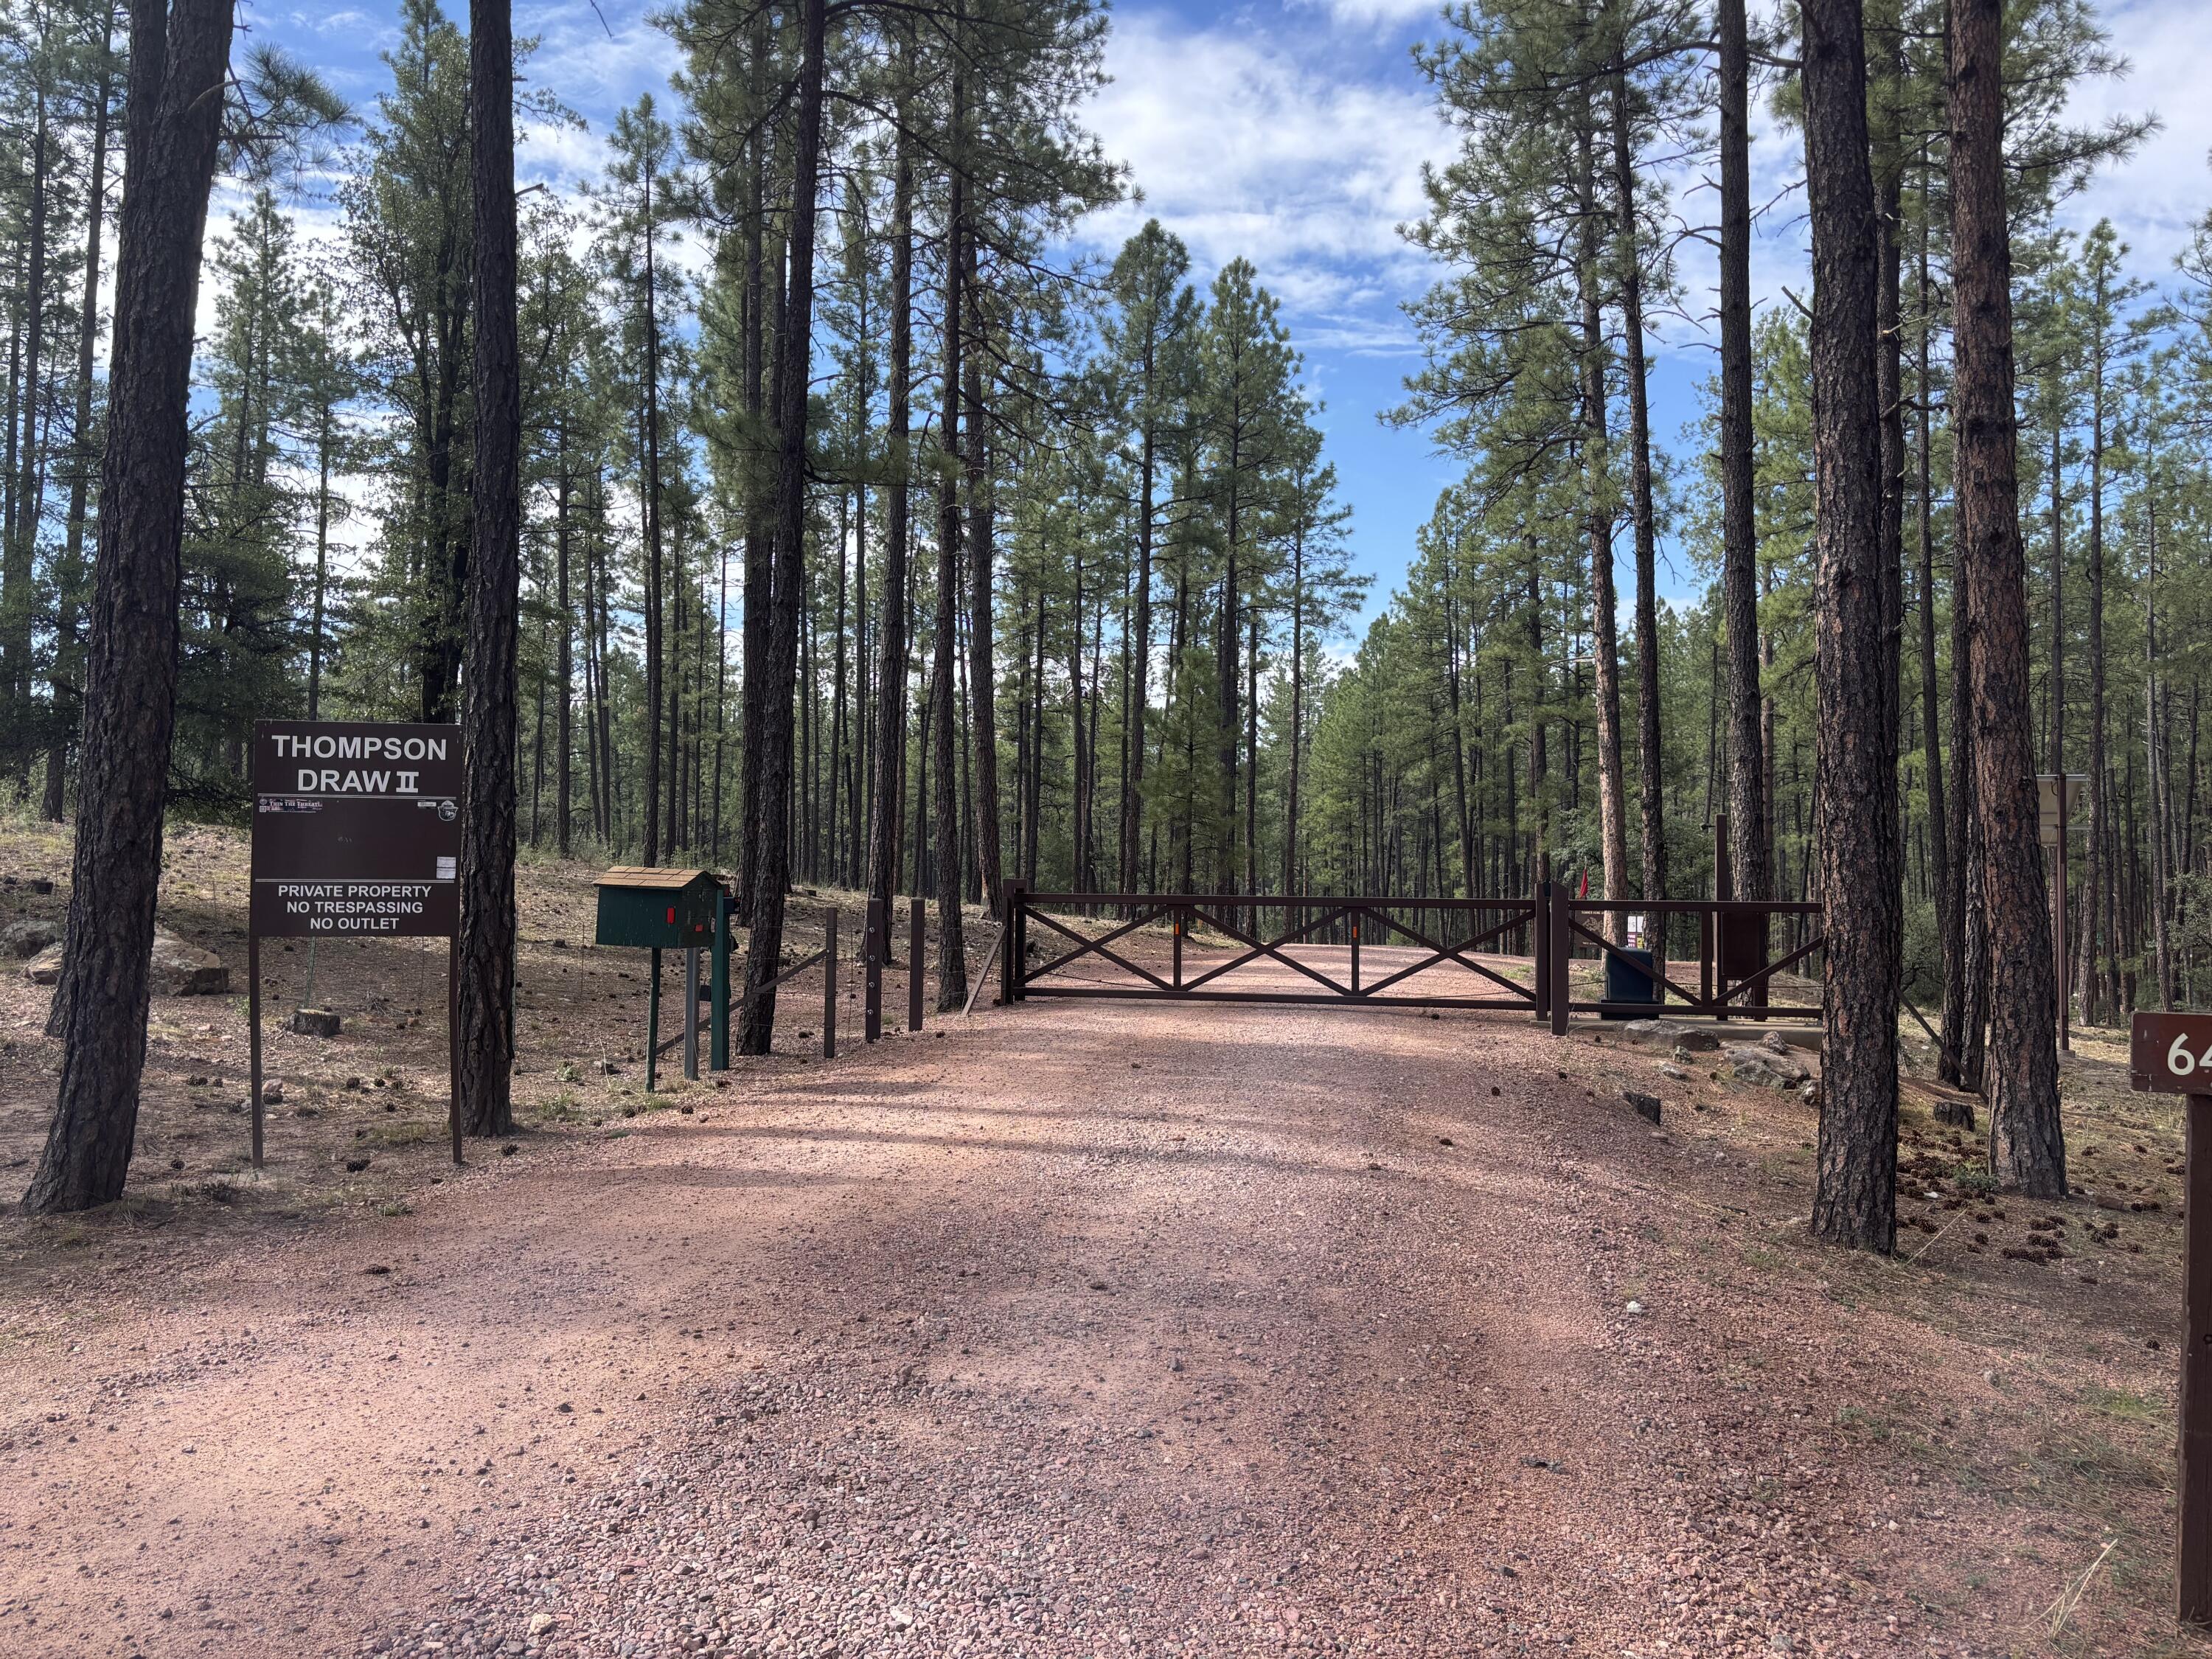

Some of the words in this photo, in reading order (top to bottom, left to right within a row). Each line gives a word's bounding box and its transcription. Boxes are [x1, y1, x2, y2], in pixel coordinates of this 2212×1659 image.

[271, 734, 447, 761] THOMPSON
[298, 769, 391, 793] DRAW
[395, 771, 420, 793] II
[278, 885, 344, 897] PRIVATE
[348, 885, 432, 897] PROPERTY
[287, 901, 310, 914] NO
[314, 901, 423, 914] TRESPASSING
[310, 917, 333, 930] NO
[338, 917, 400, 930] OUTLET
